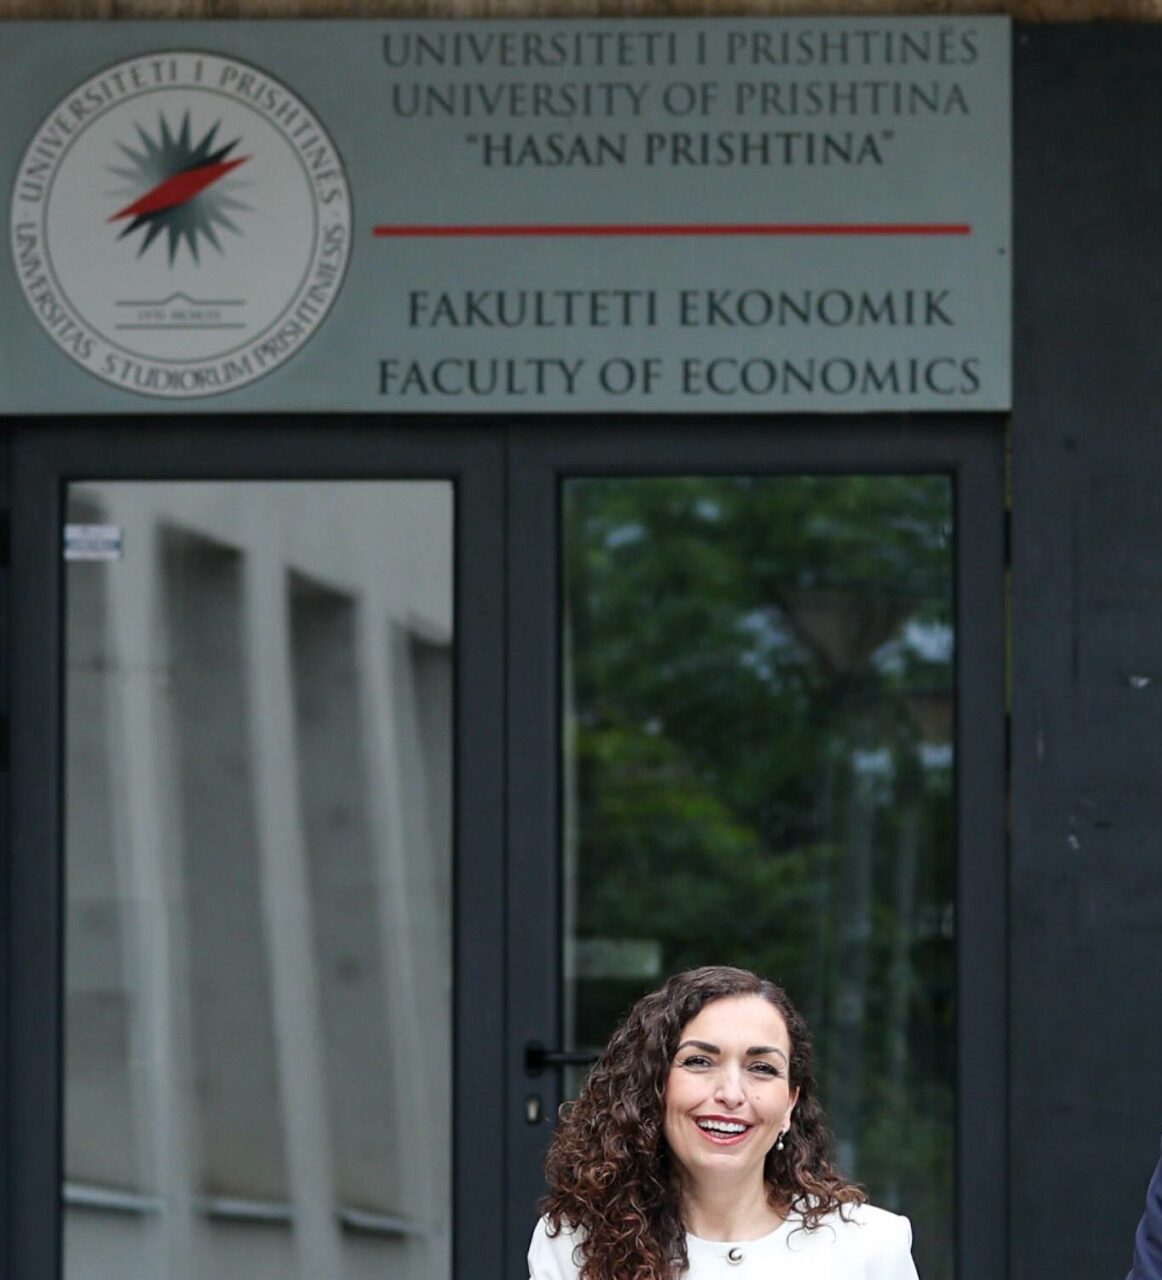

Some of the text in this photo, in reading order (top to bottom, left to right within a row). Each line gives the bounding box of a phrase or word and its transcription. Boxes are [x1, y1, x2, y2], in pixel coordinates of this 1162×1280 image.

[381, 25, 979, 68] UNIVERSITETI I PRISHTINËS
[390, 80, 971, 118] UNIVERSITY OF PRISHTINA
[21, 59, 178, 204] UNIVERSITETI
[194, 60, 204, 82] I
[16, 222, 96, 360] UNIVERSITAS
[101, 352, 253, 390] STUDIORUM
[407, 289, 954, 328] FAKULTETI EKONOMIK
[378, 357, 982, 396] FACULTY OF ECONOMICS
